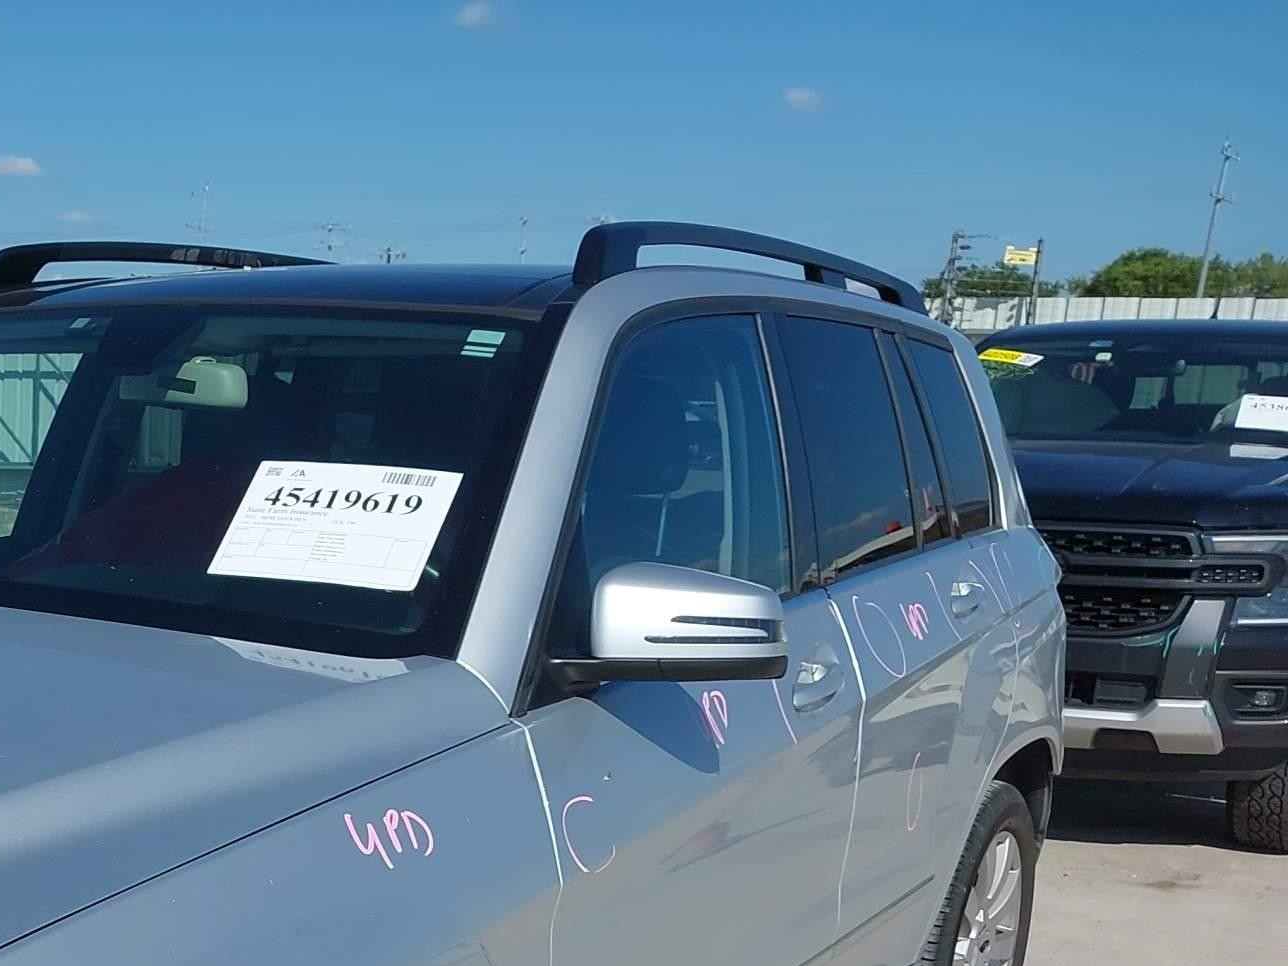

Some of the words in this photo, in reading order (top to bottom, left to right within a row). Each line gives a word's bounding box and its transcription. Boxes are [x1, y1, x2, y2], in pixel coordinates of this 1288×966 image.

[263, 485, 424, 516] 45419619
[247, 506, 266, 514] State
[267, 506, 288, 515] Farm
[290, 507, 329, 517] Insurance
